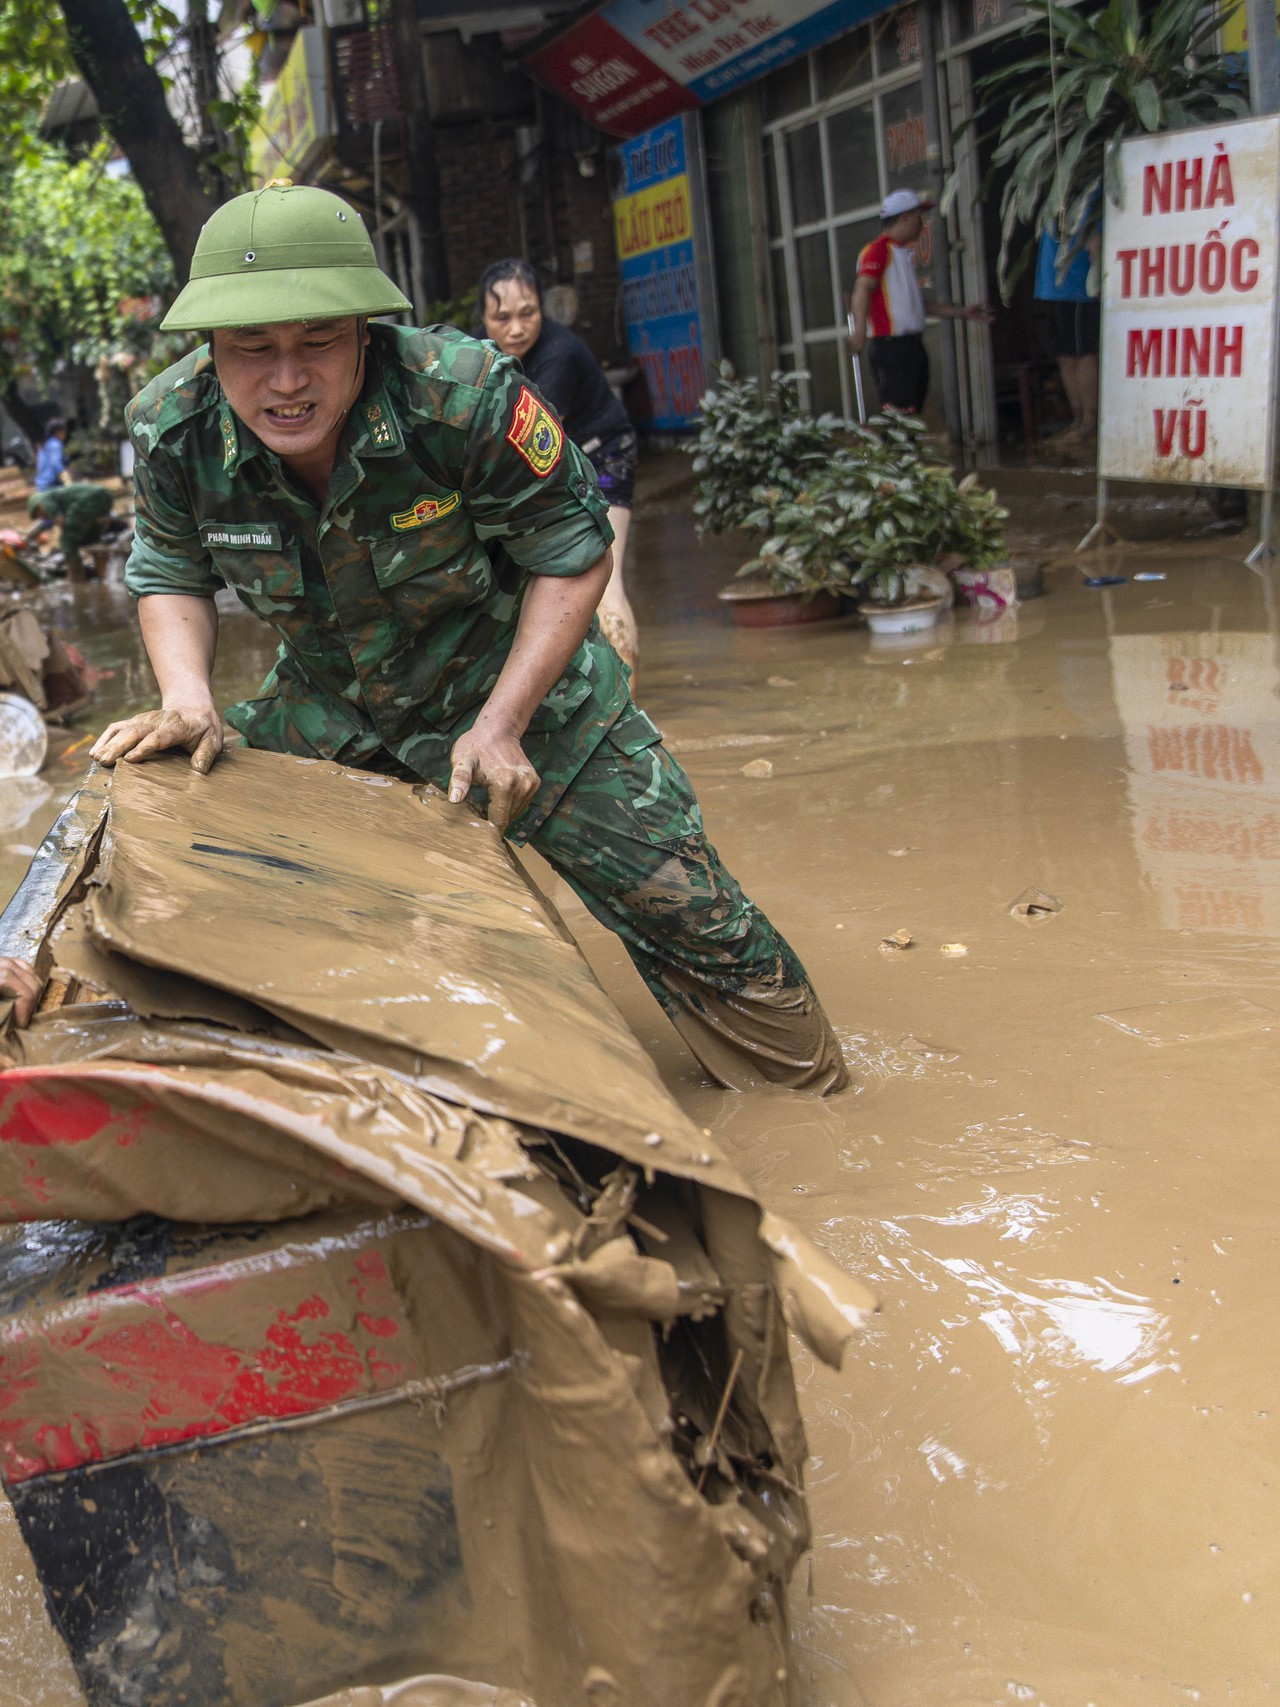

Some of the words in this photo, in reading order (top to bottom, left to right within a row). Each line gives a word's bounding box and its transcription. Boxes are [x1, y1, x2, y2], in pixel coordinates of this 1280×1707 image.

[1142, 143, 1235, 216] NHÀ
[1116, 220, 1260, 299] THUỐC
[1126, 326, 1243, 378] MINH
[1153, 399, 1208, 459] VŨ
[207, 532, 230, 544] PHẠM
[230, 534, 251, 545] MINH
[251, 531, 272, 545] TUẤN
